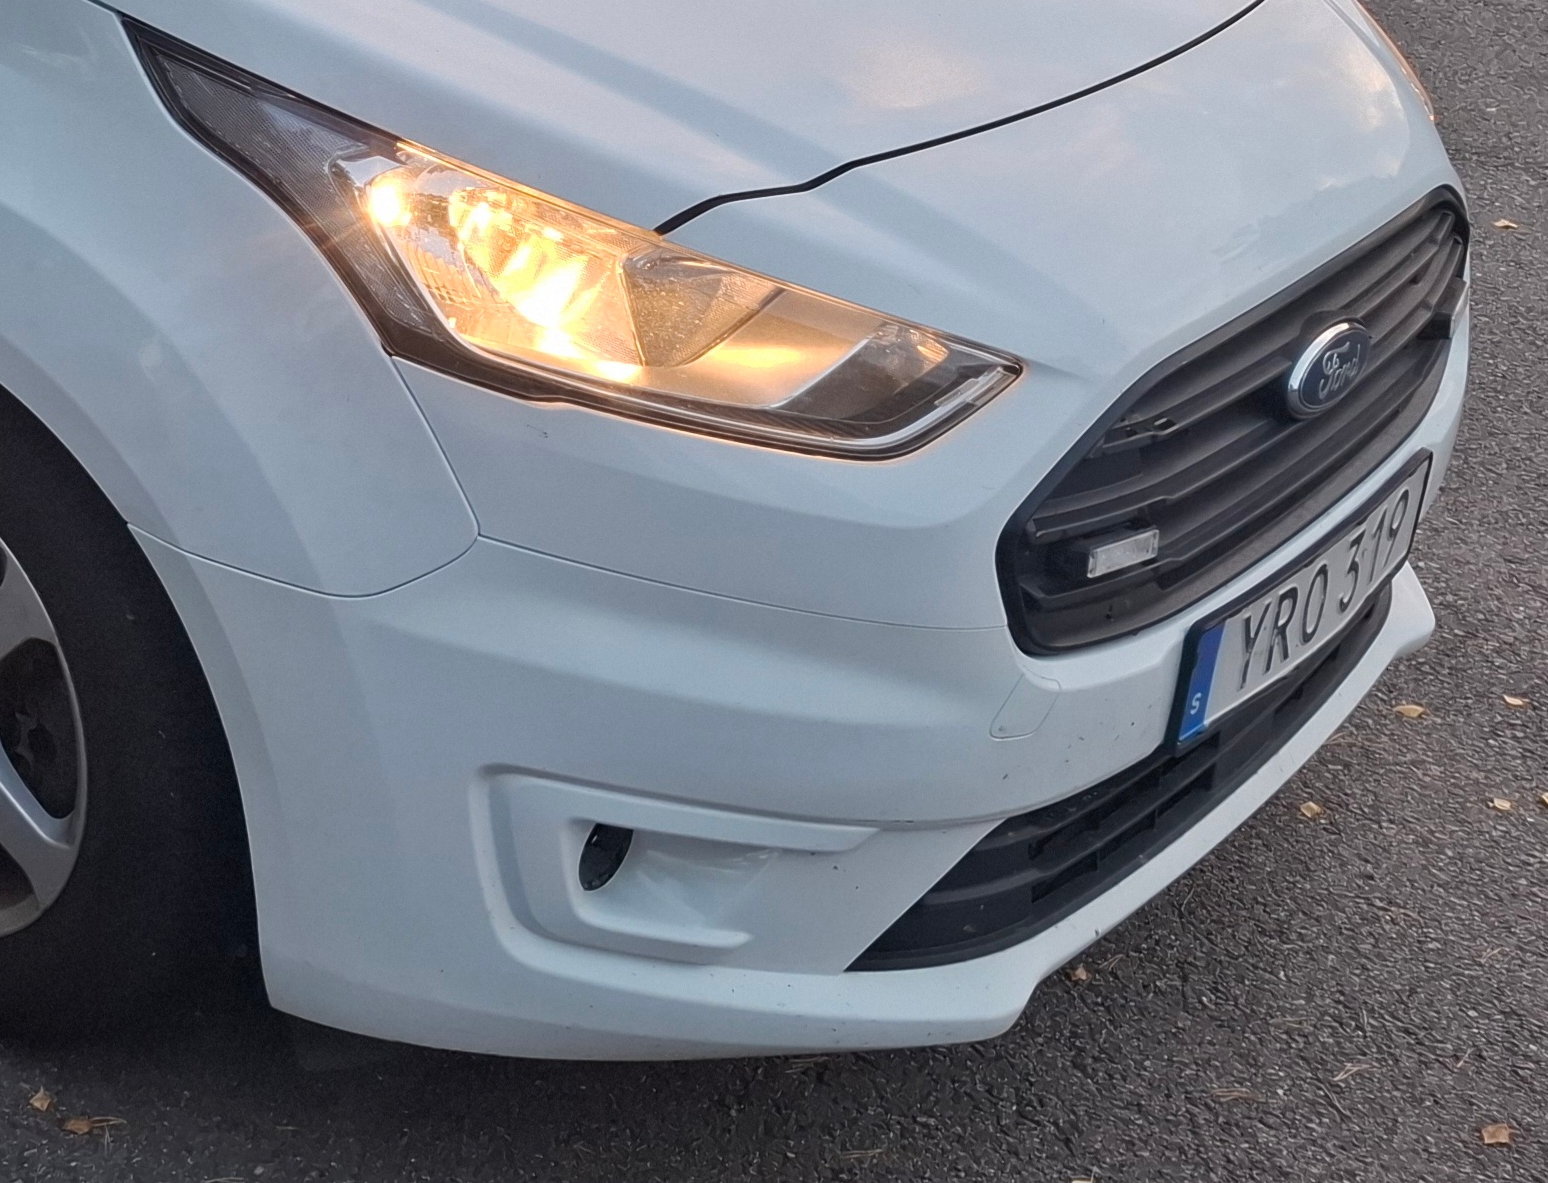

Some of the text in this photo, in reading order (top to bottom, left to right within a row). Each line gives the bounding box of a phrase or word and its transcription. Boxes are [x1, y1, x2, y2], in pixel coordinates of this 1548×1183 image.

[1318, 340, 1361, 400] Ford
[1239, 488, 1410, 691] YRO 319
[1189, 692, 1203, 716] S
